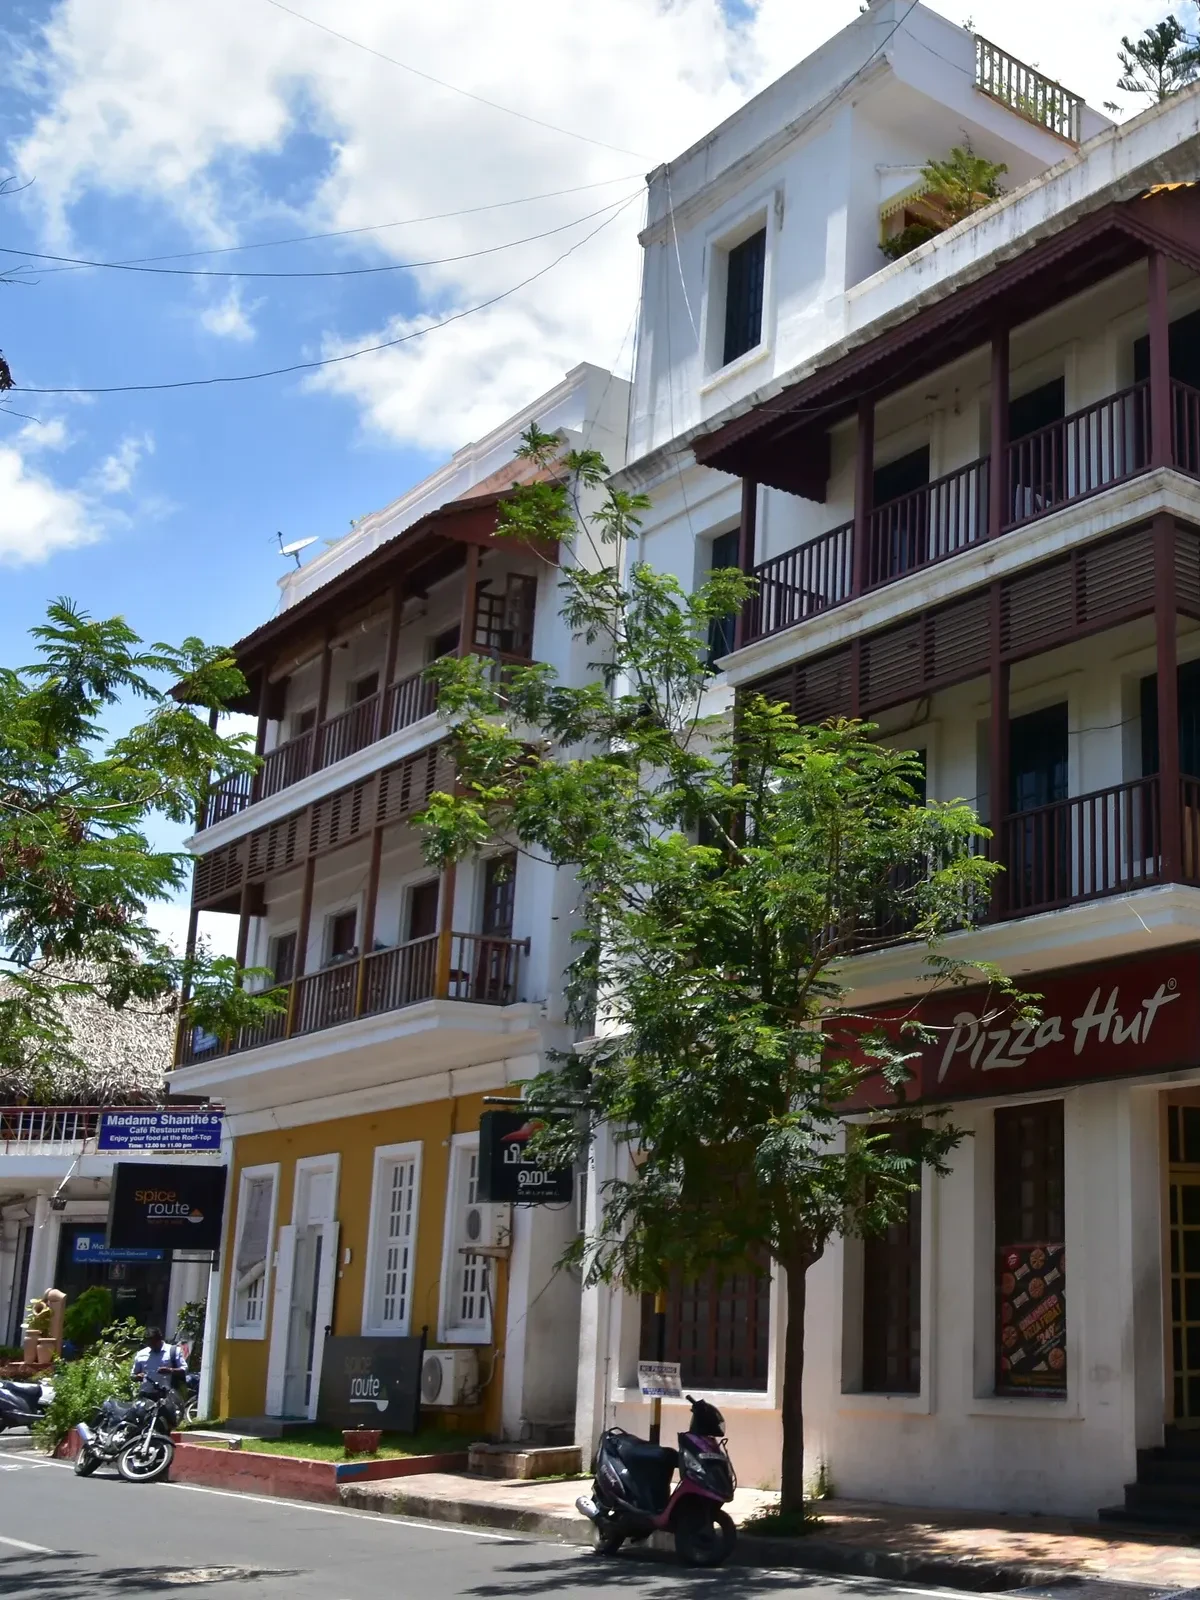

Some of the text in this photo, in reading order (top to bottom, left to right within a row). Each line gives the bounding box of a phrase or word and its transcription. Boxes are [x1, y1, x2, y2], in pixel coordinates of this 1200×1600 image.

[937, 983, 1181, 1084] Pizza Hut
[107, 1115, 158, 1126] Madame
[129, 1126, 148, 1134] Café
[135, 1188, 176, 1204] spice
[148, 1201, 190, 1215] route
[351, 1374, 380, 1397] route
